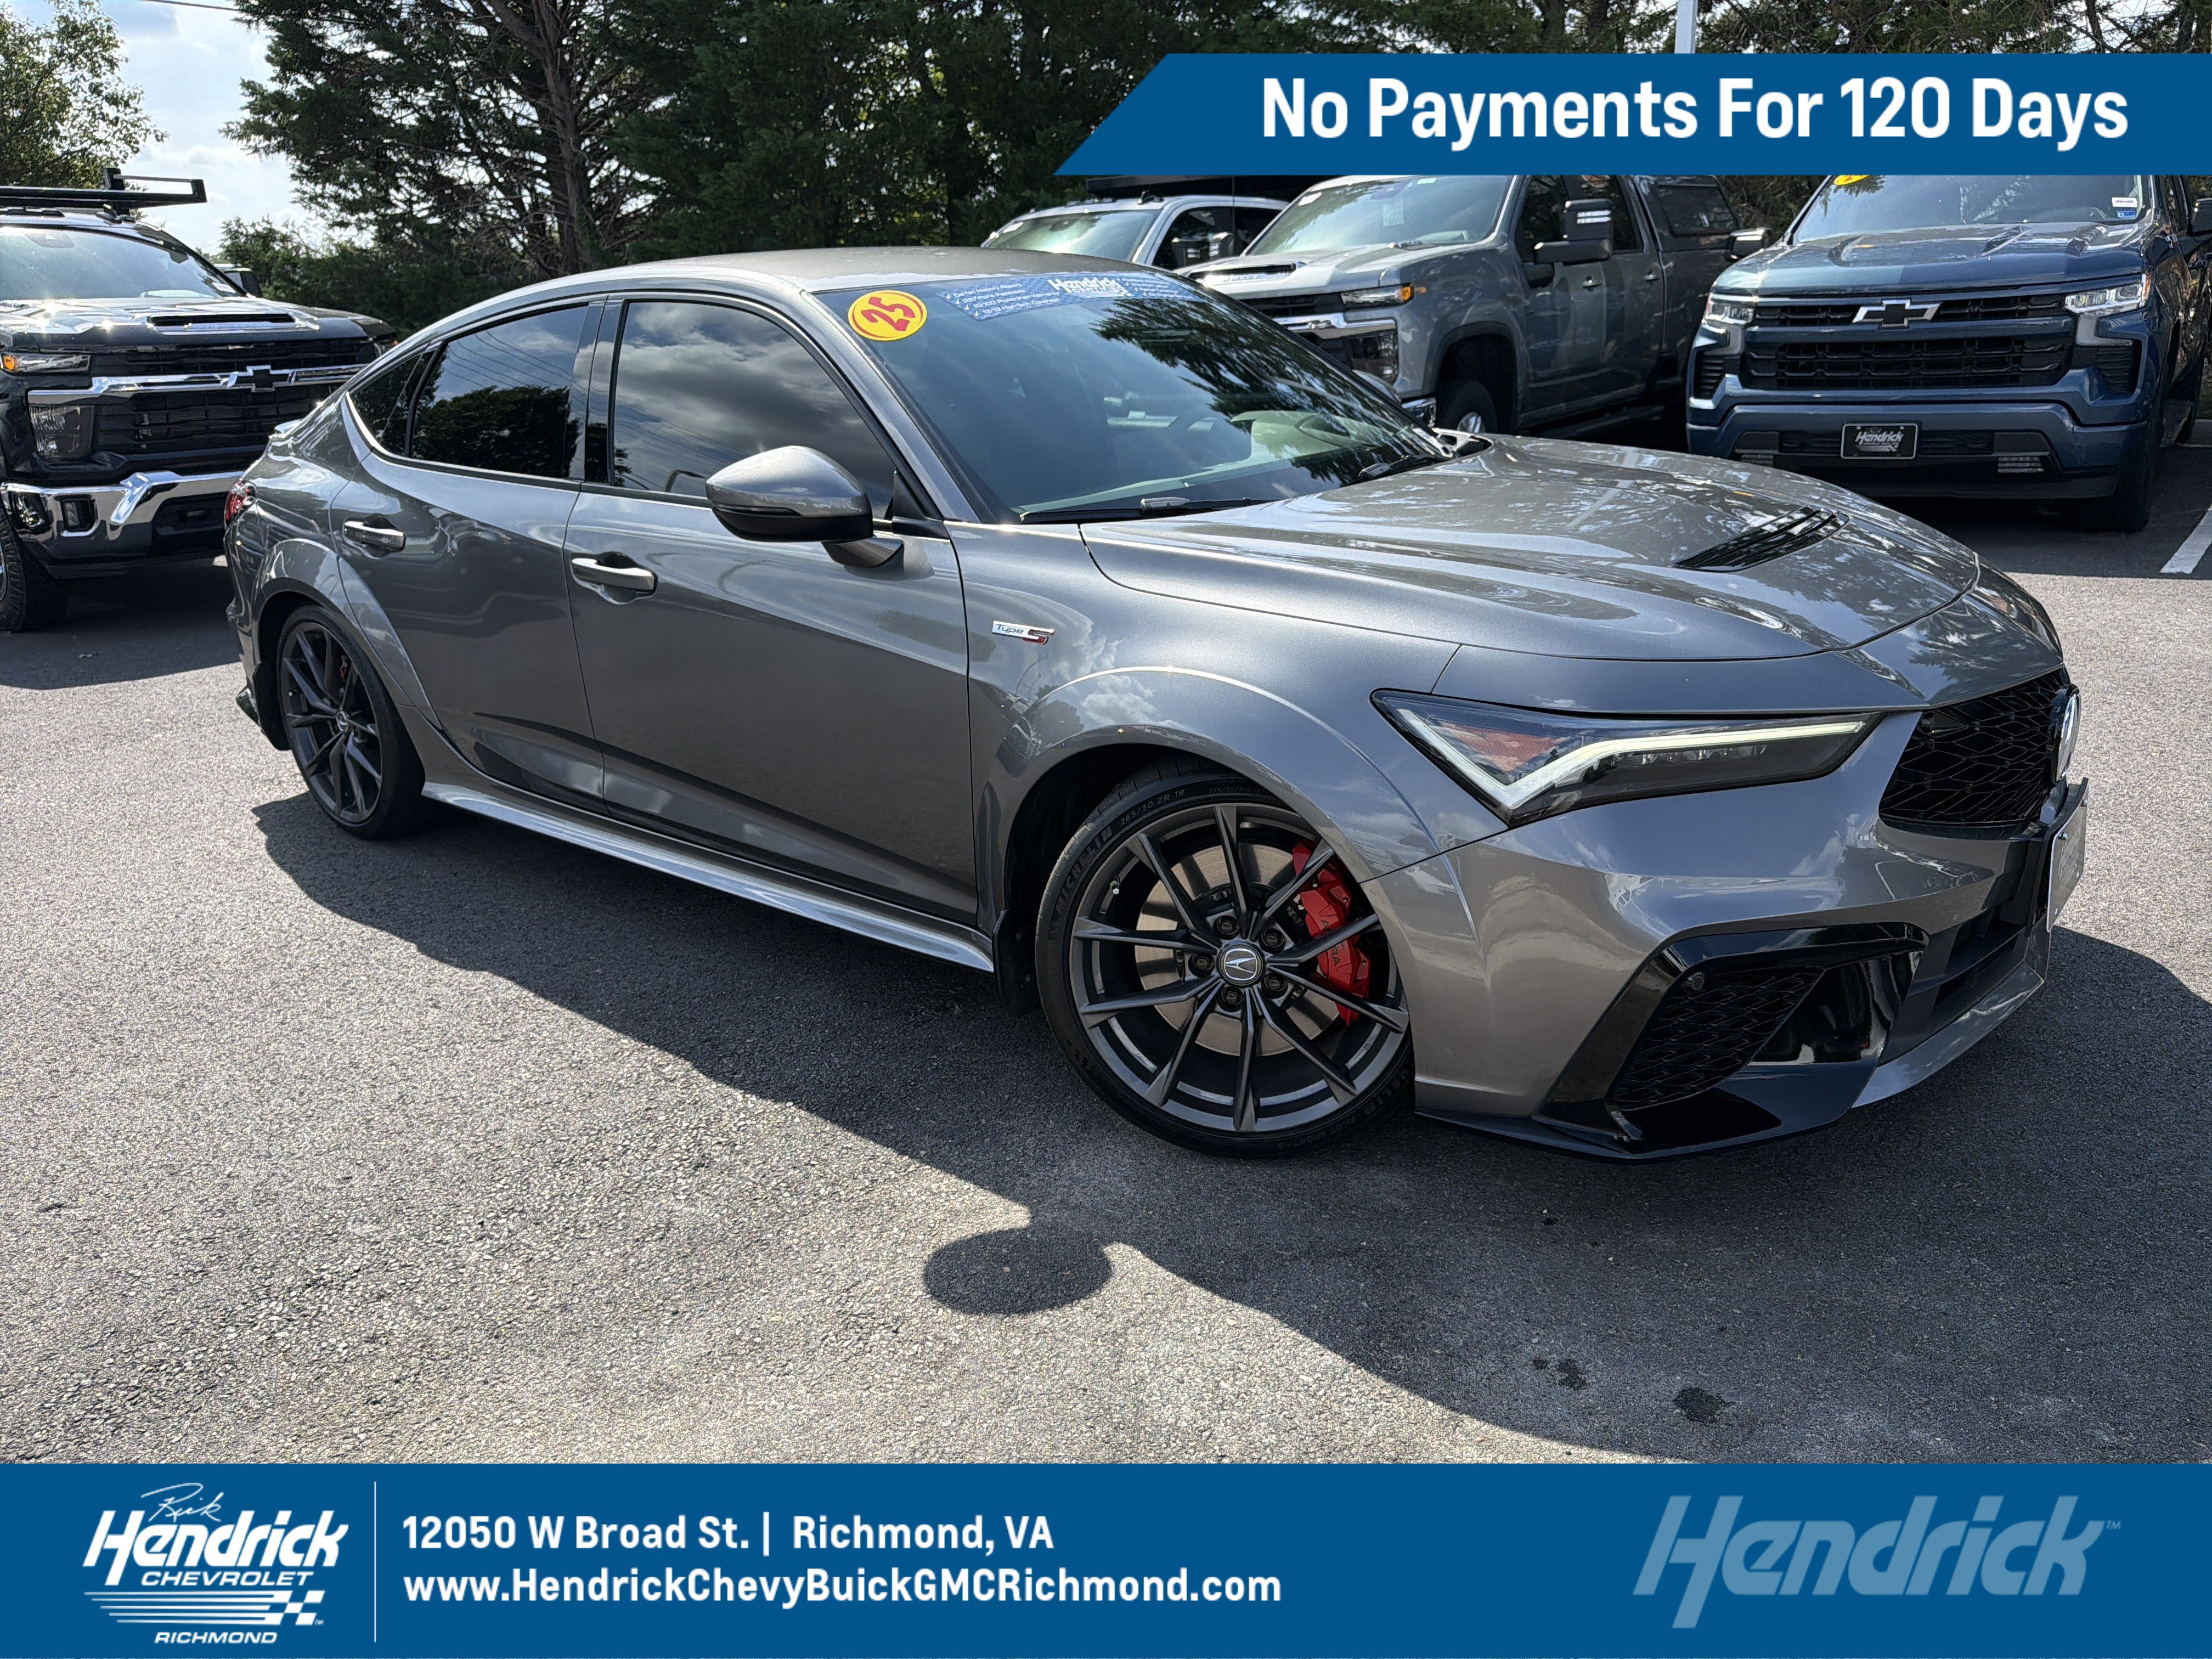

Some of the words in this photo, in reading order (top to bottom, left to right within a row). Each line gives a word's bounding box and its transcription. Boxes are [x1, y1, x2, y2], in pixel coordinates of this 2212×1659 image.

[1047, 277, 1121, 293] Hendrick
[860, 296, 916, 331] 25
[1855, 431, 1904, 445] Hendrick
[995, 624, 1024, 634] Type
[1022, 629, 1055, 645] S
[1120, 801, 1153, 826] 265/30
[1157, 794, 1170, 805] ZR
[1174, 789, 1184, 798] 19
[1054, 825, 1113, 916] MICHELIN
